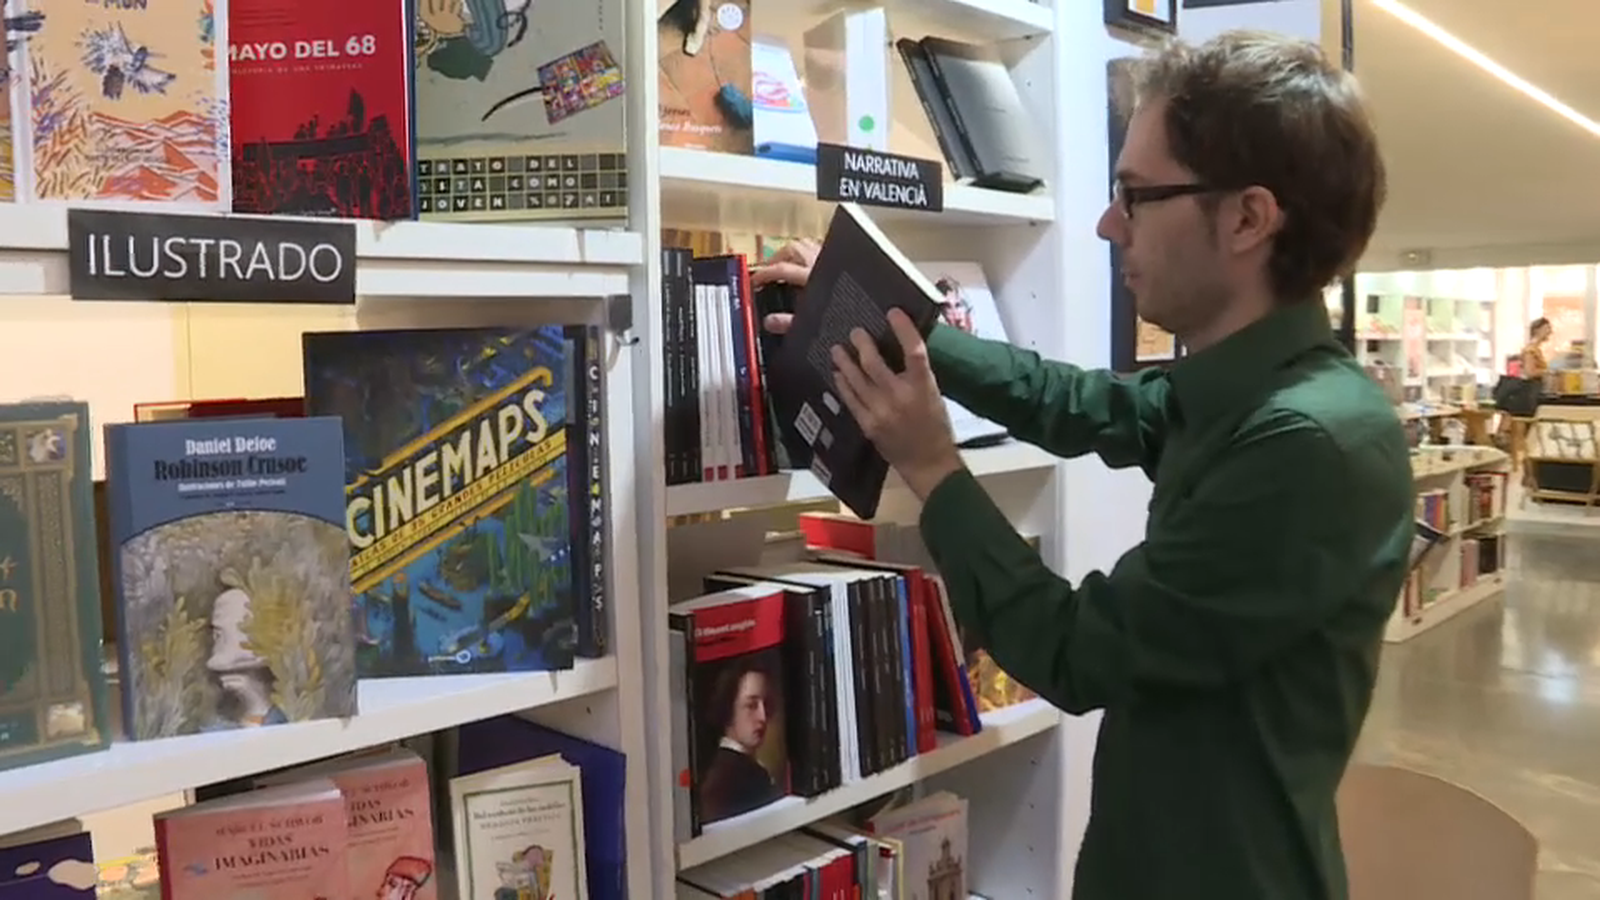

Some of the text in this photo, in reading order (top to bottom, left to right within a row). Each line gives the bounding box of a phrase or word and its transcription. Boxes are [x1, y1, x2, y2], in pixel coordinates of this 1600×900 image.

[295, 40, 340, 58] DEL
[345, 34, 376, 55] 68
[420, 158, 574, 173] TRATO DEL
[843, 151, 920, 180] NARRATIVA
[511, 176, 576, 189] COMO
[839, 176, 928, 207] EN VALENCIÀ
[421, 195, 503, 210] JOVEN
[88, 233, 342, 282] ILUSTRADO
[185, 434, 277, 456] Daniel Defoe
[153, 454, 308, 481] Robinson Crusoe
[347, 388, 547, 548] CINEMAPS
[348, 800, 381, 812] IDAS
[248, 833, 293, 848] VIDAS
[214, 846, 329, 870] IMAGINARIAS
